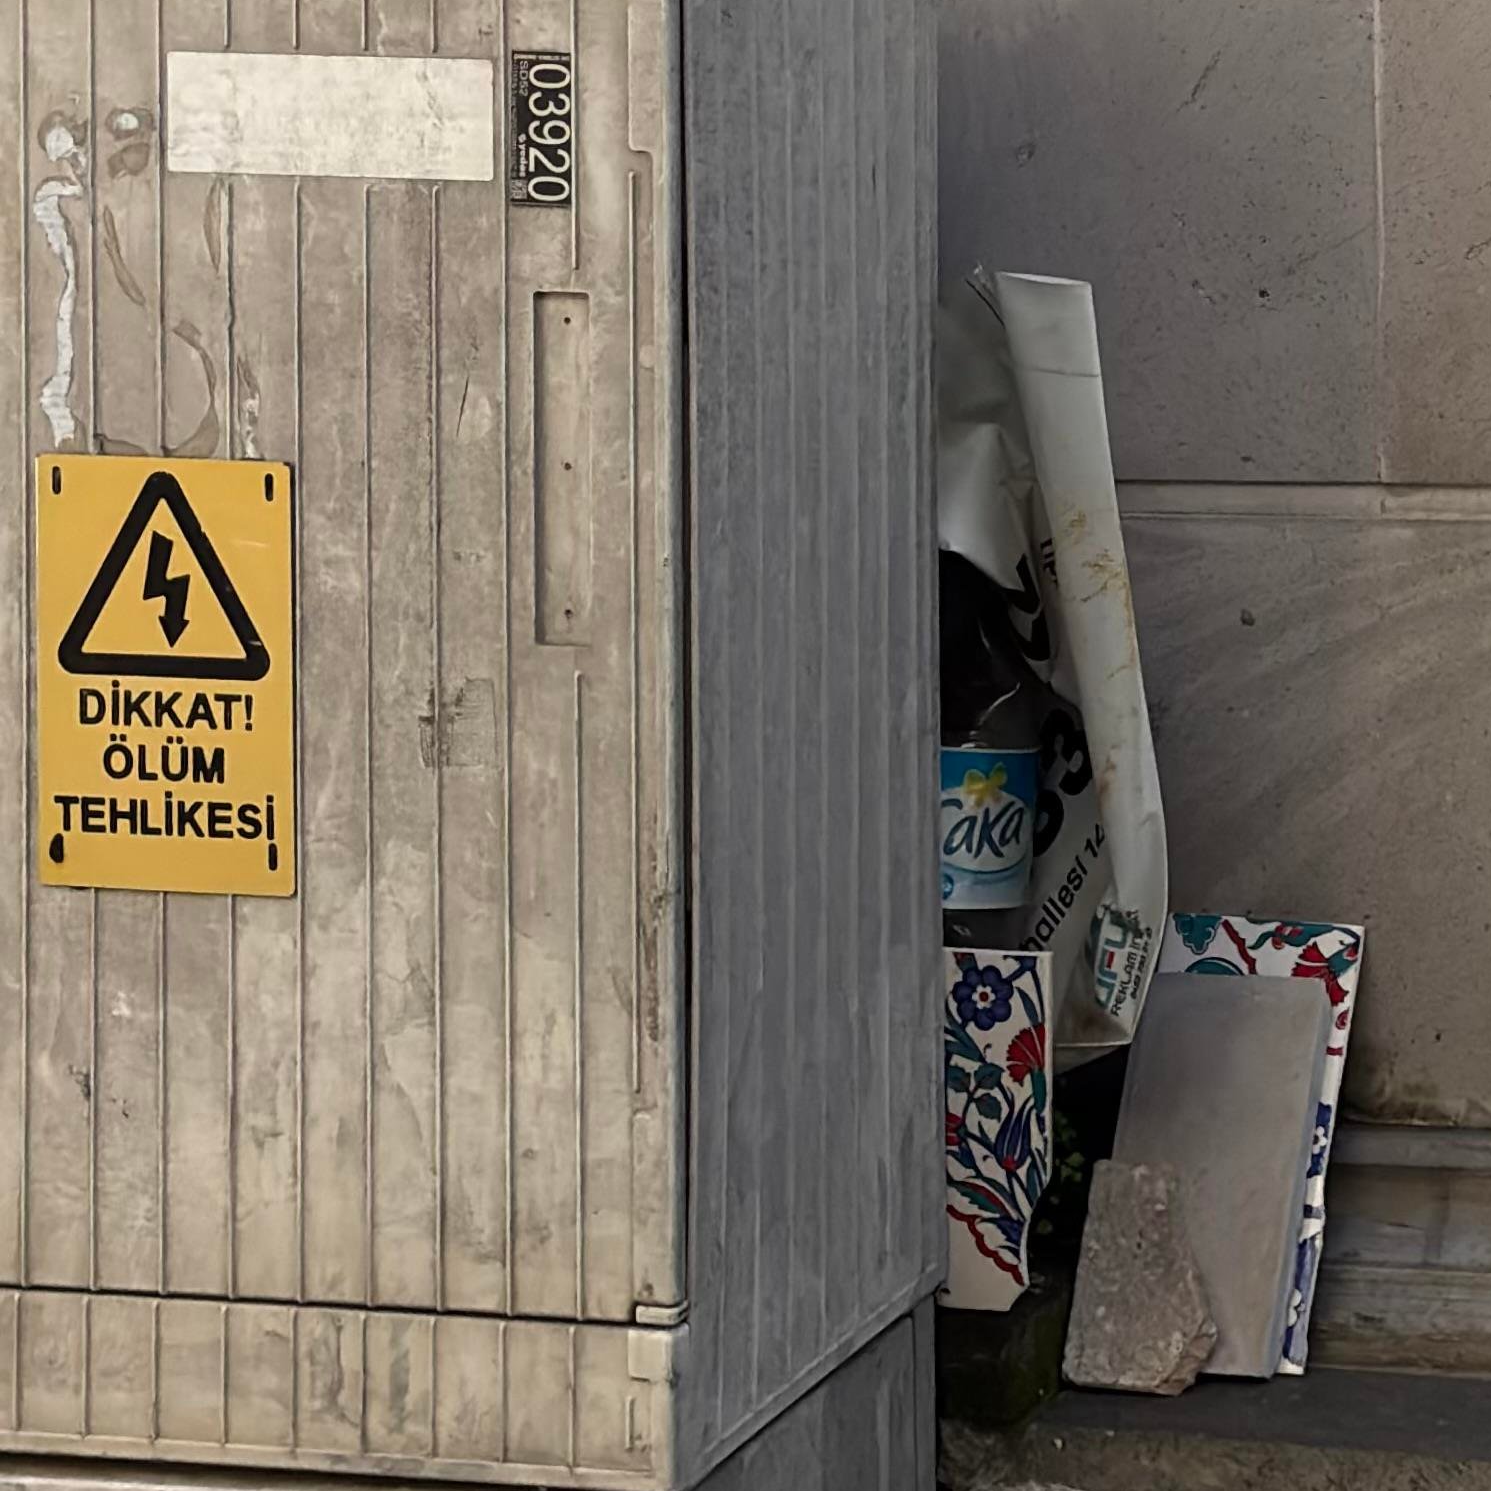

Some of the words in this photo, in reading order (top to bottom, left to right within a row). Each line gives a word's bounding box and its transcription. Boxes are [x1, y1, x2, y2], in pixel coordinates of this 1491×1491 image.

[518, 59, 529, 97] SD52
[527, 62, 571, 202] 03920
[79, 679, 253, 731] DİKKAT!
[103, 733, 225, 784] ÖLÜM
[54, 790, 275, 841] TEHLİKESİ
